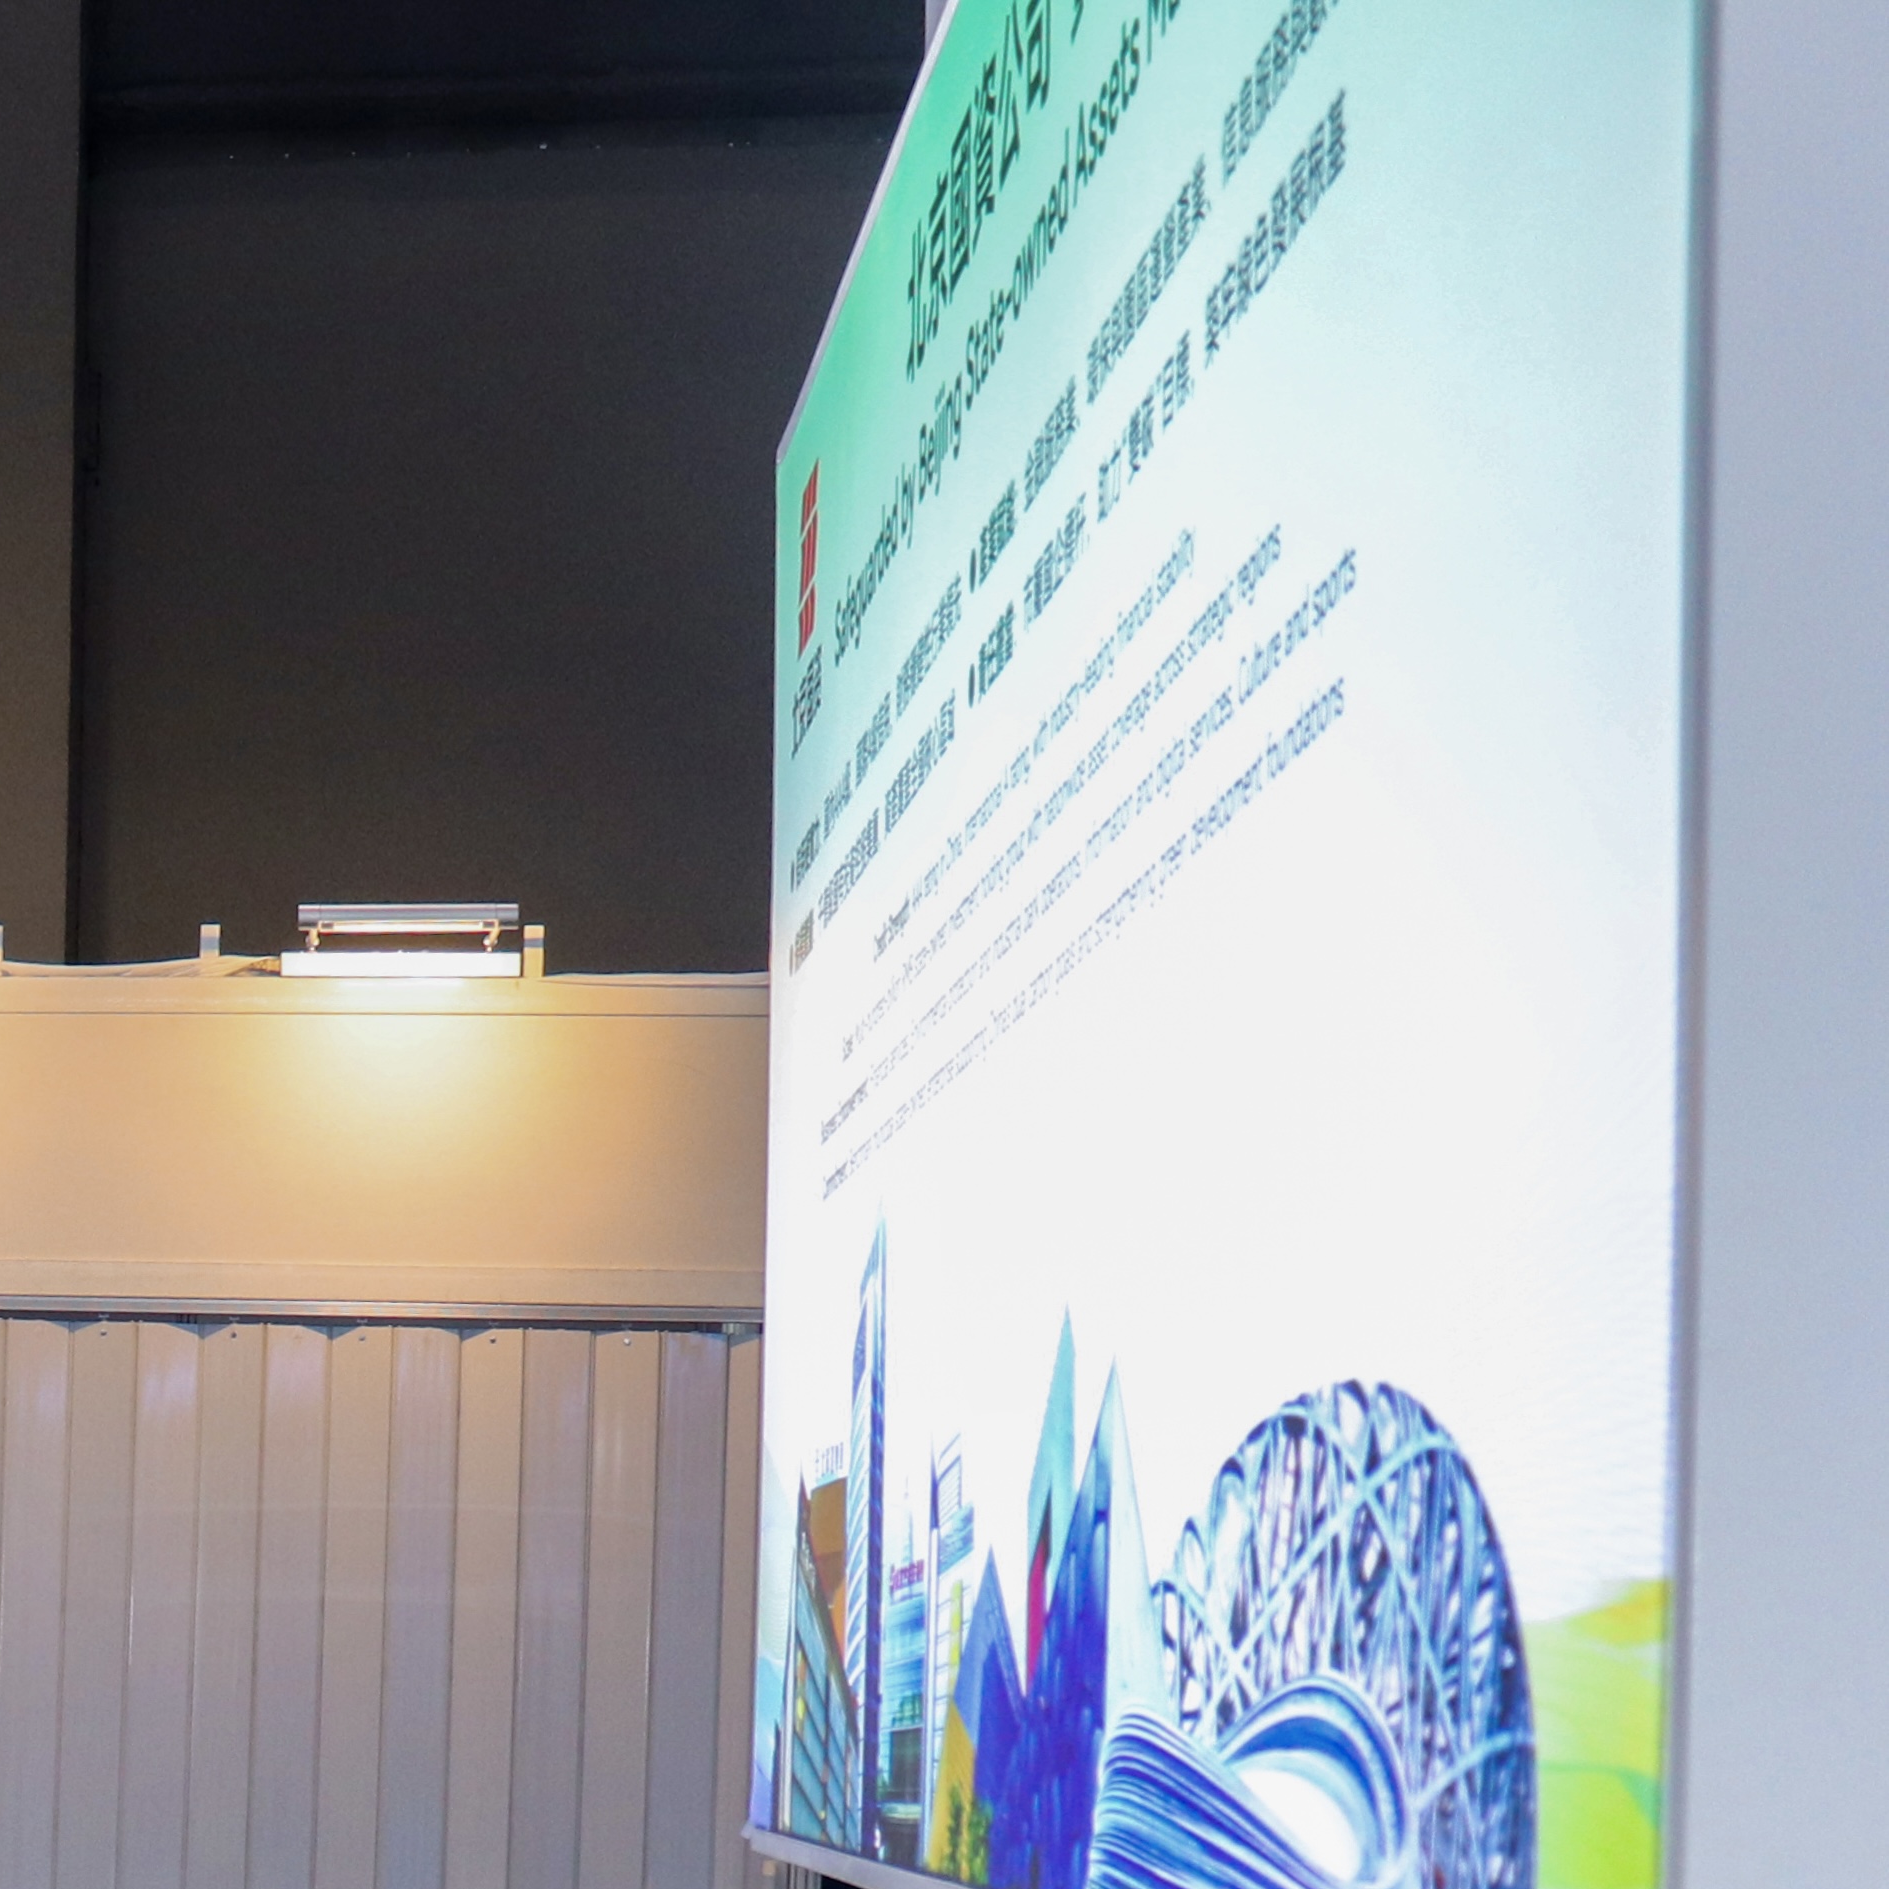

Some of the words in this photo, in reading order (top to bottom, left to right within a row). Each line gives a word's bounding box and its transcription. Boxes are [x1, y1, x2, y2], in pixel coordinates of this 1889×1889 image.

[835, 477, 898, 667] Safeguarded
[901, 464, 915, 549] by
[919, 373, 961, 503] Beijing
[965, 129, 1069, 411] State-owned
[1073, 18, 1139, 207] Assets
[1237, 524, 1280, 598] regions
[1239, 631, 1281, 705] Culture
[1285, 600, 1309, 656] and
[1312, 549, 1356, 627] sports
[1191, 755, 1263, 854] development
[1266, 678, 1344, 778] foundations
